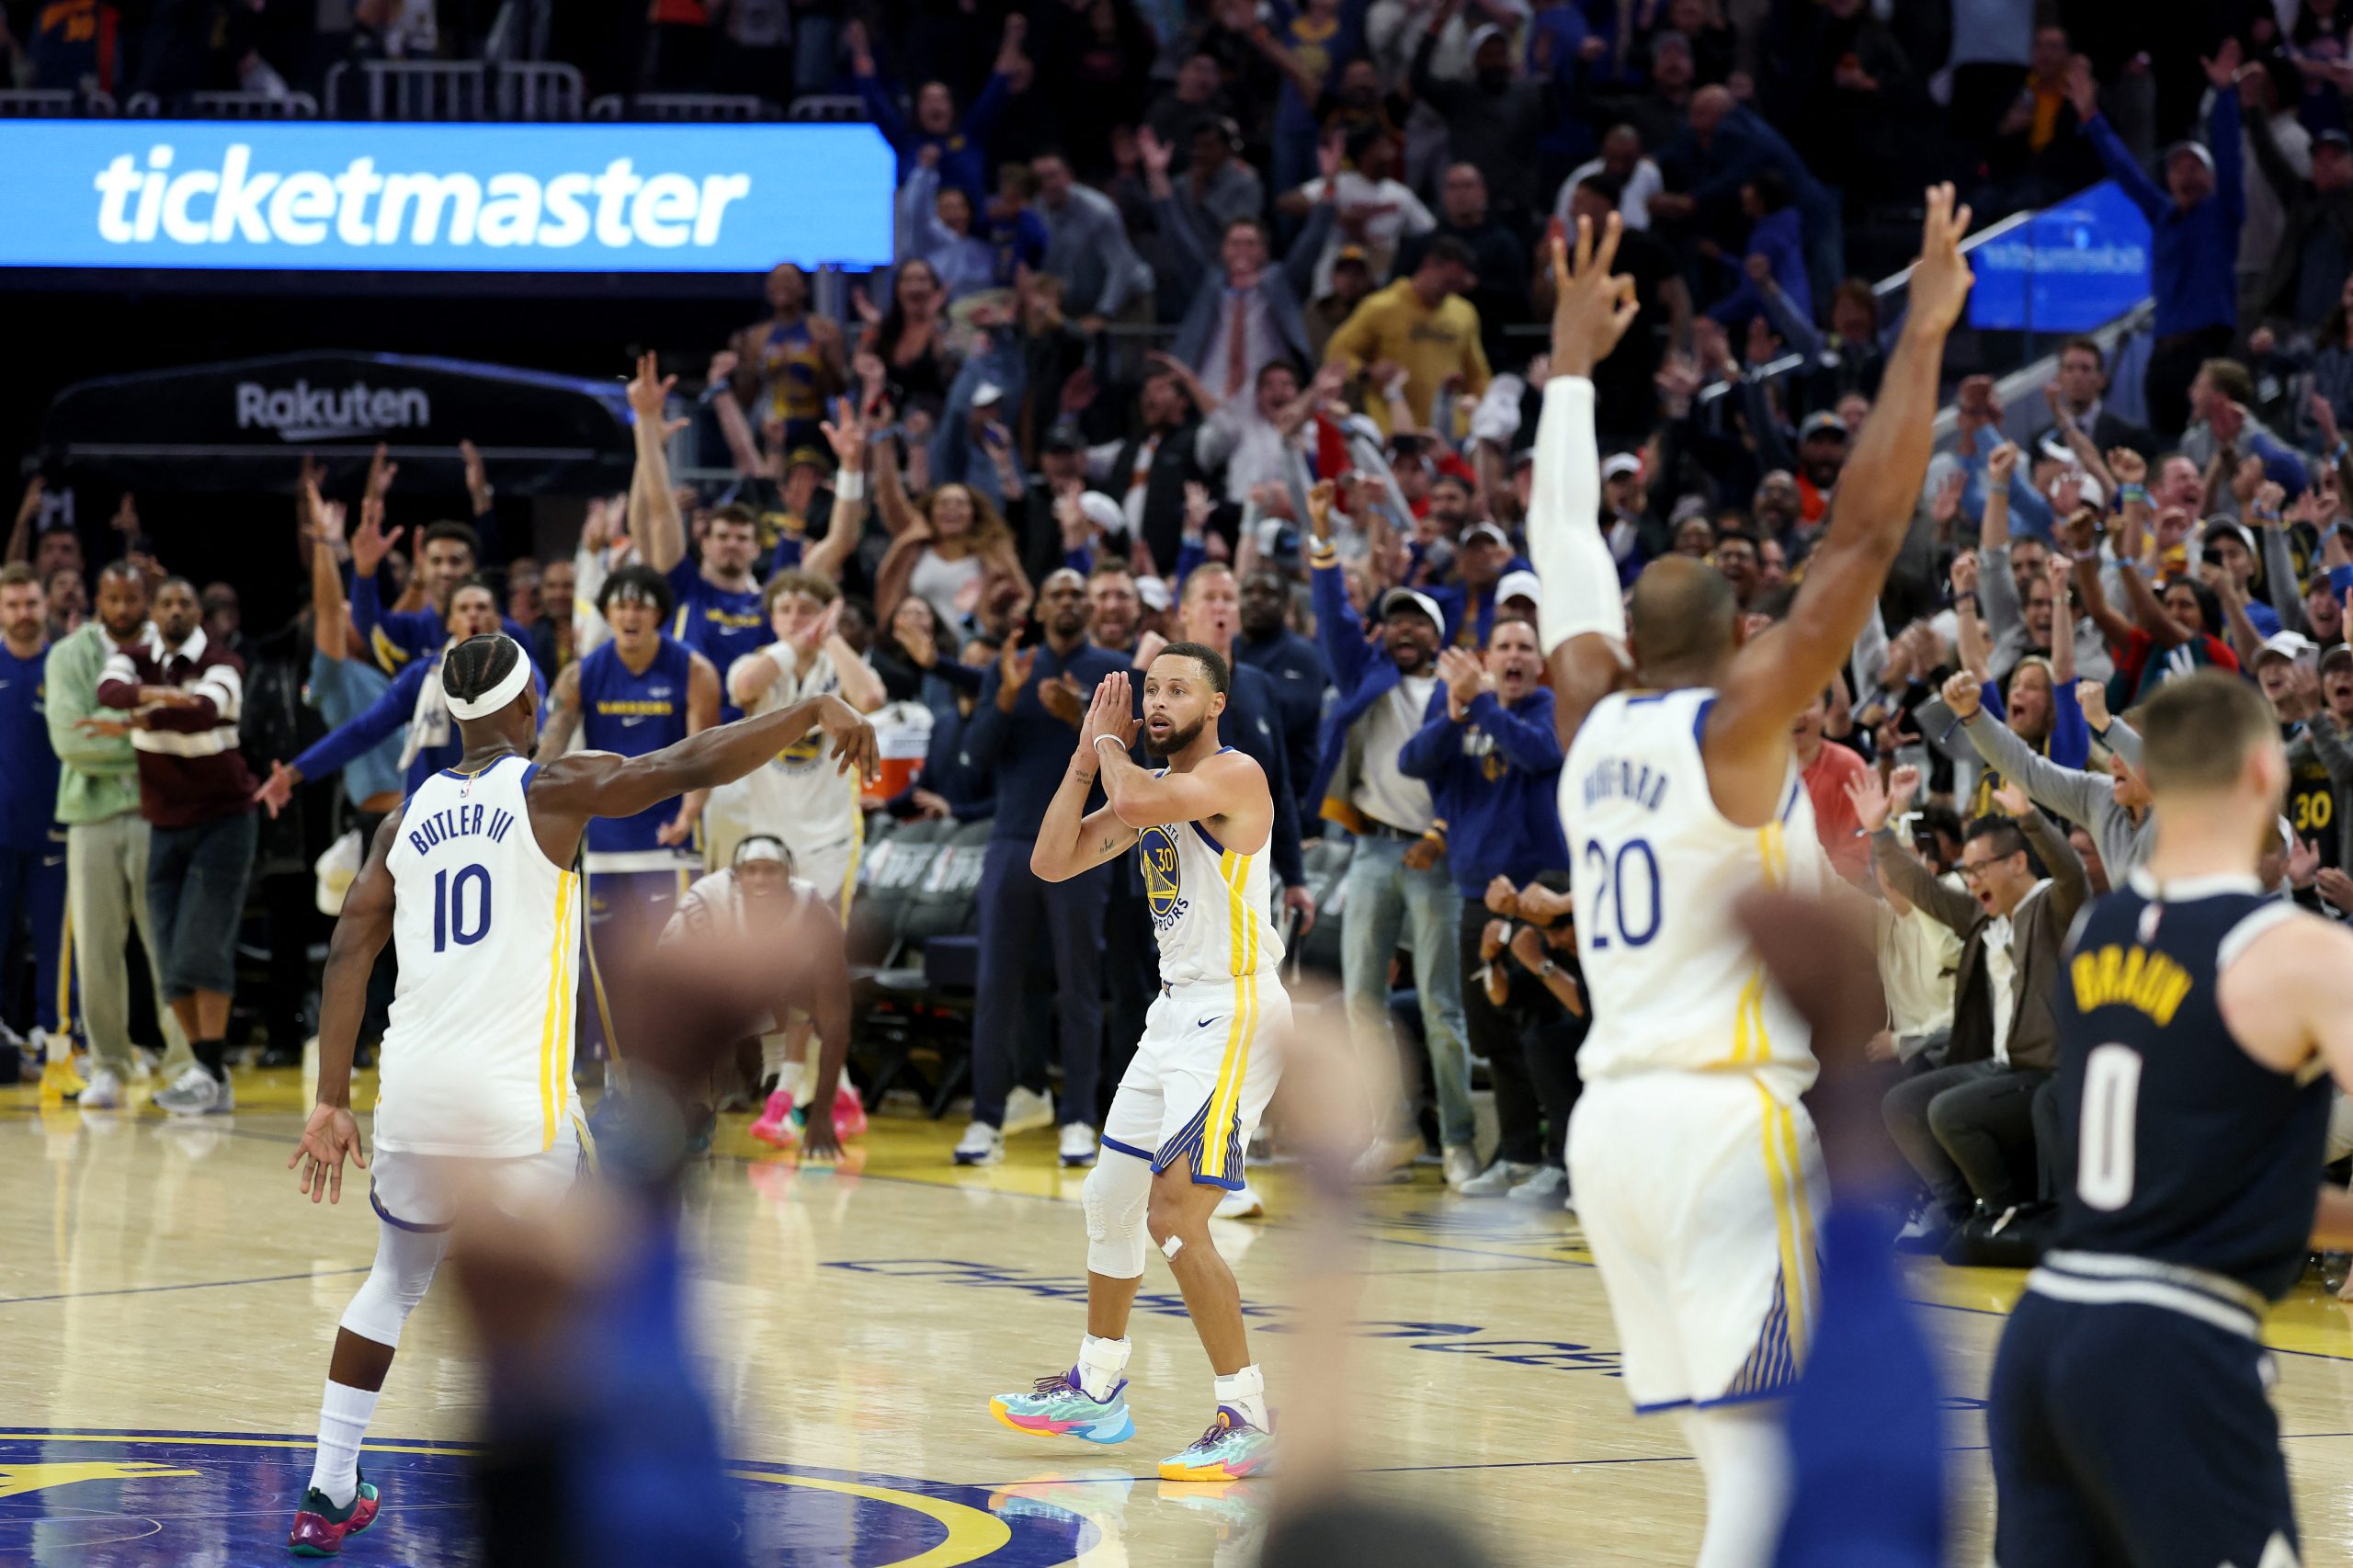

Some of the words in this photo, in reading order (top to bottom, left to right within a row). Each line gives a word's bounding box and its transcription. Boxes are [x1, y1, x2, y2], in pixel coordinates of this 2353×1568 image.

[95, 143, 751, 246] ticketmaster
[236, 379, 430, 428] Rakuten
[409, 804, 484, 857] BUTLER
[486, 807, 515, 844] III
[2295, 791, 2333, 831] 30
[1155, 847, 1174, 872] 30
[1586, 838, 1662, 949] 20
[434, 863, 492, 953] 10
[2070, 943, 2195, 1028] BRAUN
[2076, 1041, 2143, 1212] 0
